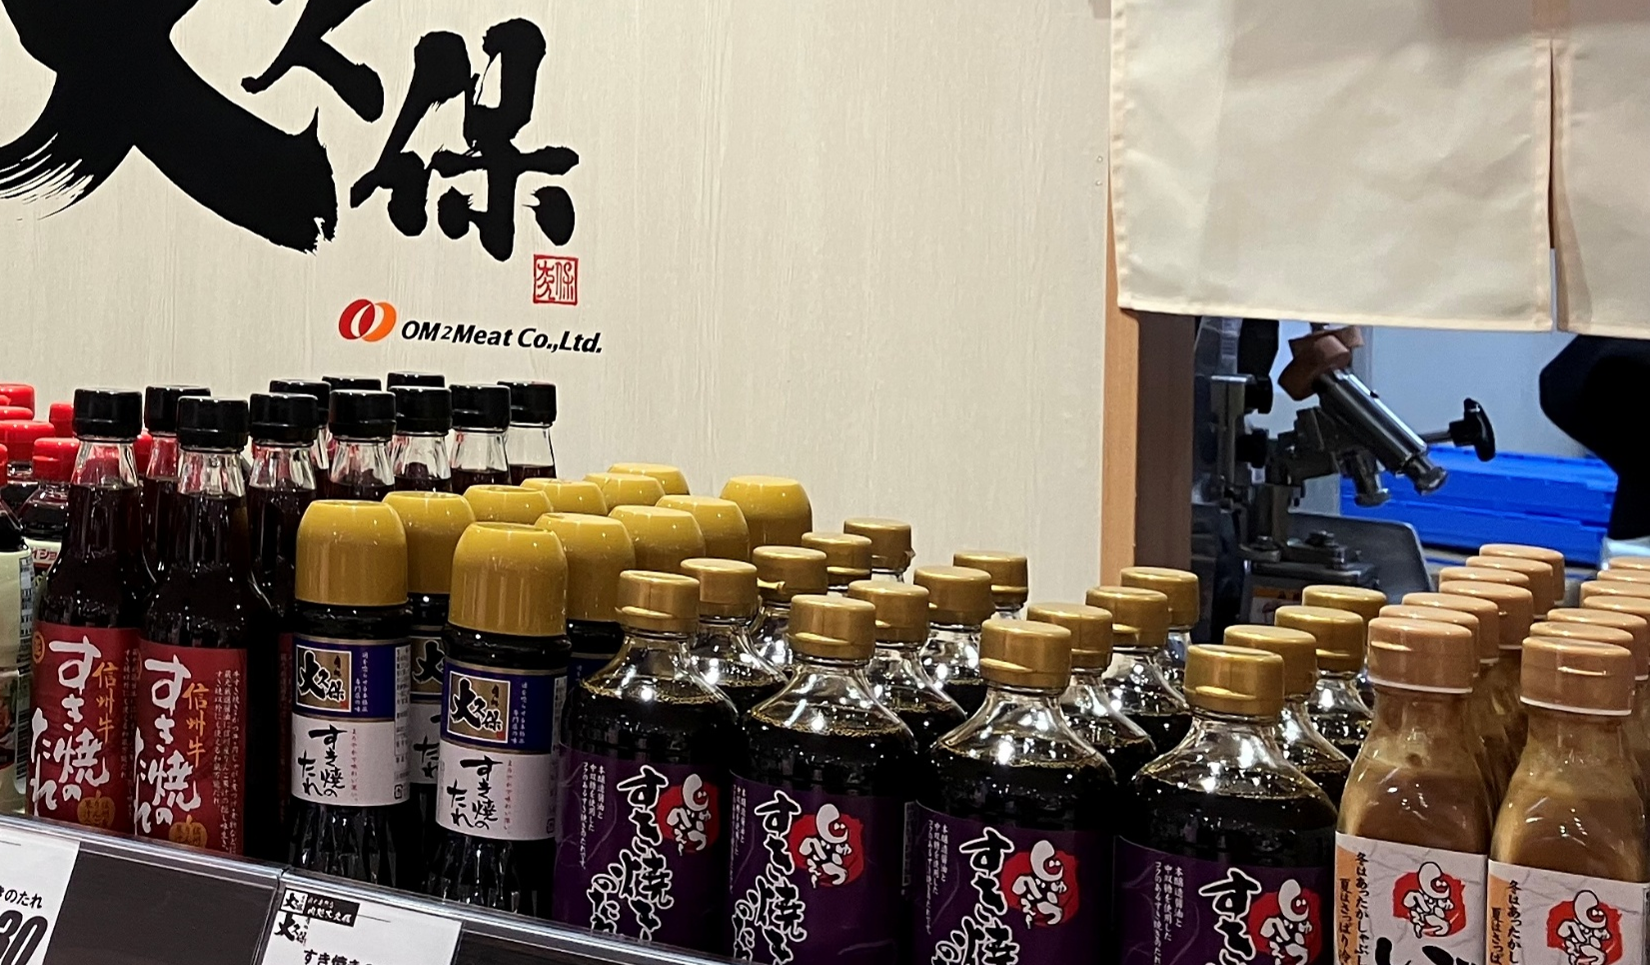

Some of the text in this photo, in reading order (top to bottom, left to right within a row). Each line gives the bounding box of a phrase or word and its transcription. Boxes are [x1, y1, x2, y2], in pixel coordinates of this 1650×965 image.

[517, 327, 603, 354] Co.,Ltd.
[48, 635, 110, 802] すき焼の
[92, 661, 120, 744] 信州牛
[144, 654, 202, 826] すき焼の
[182, 682, 211, 769] 信州牛
[450, 677, 503, 732] 大久保
[297, 750, 324, 797] たれ
[308, 724, 348, 798] すき焼の
[459, 754, 503, 830] すき焼の
[446, 779, 475, 828] たれ
